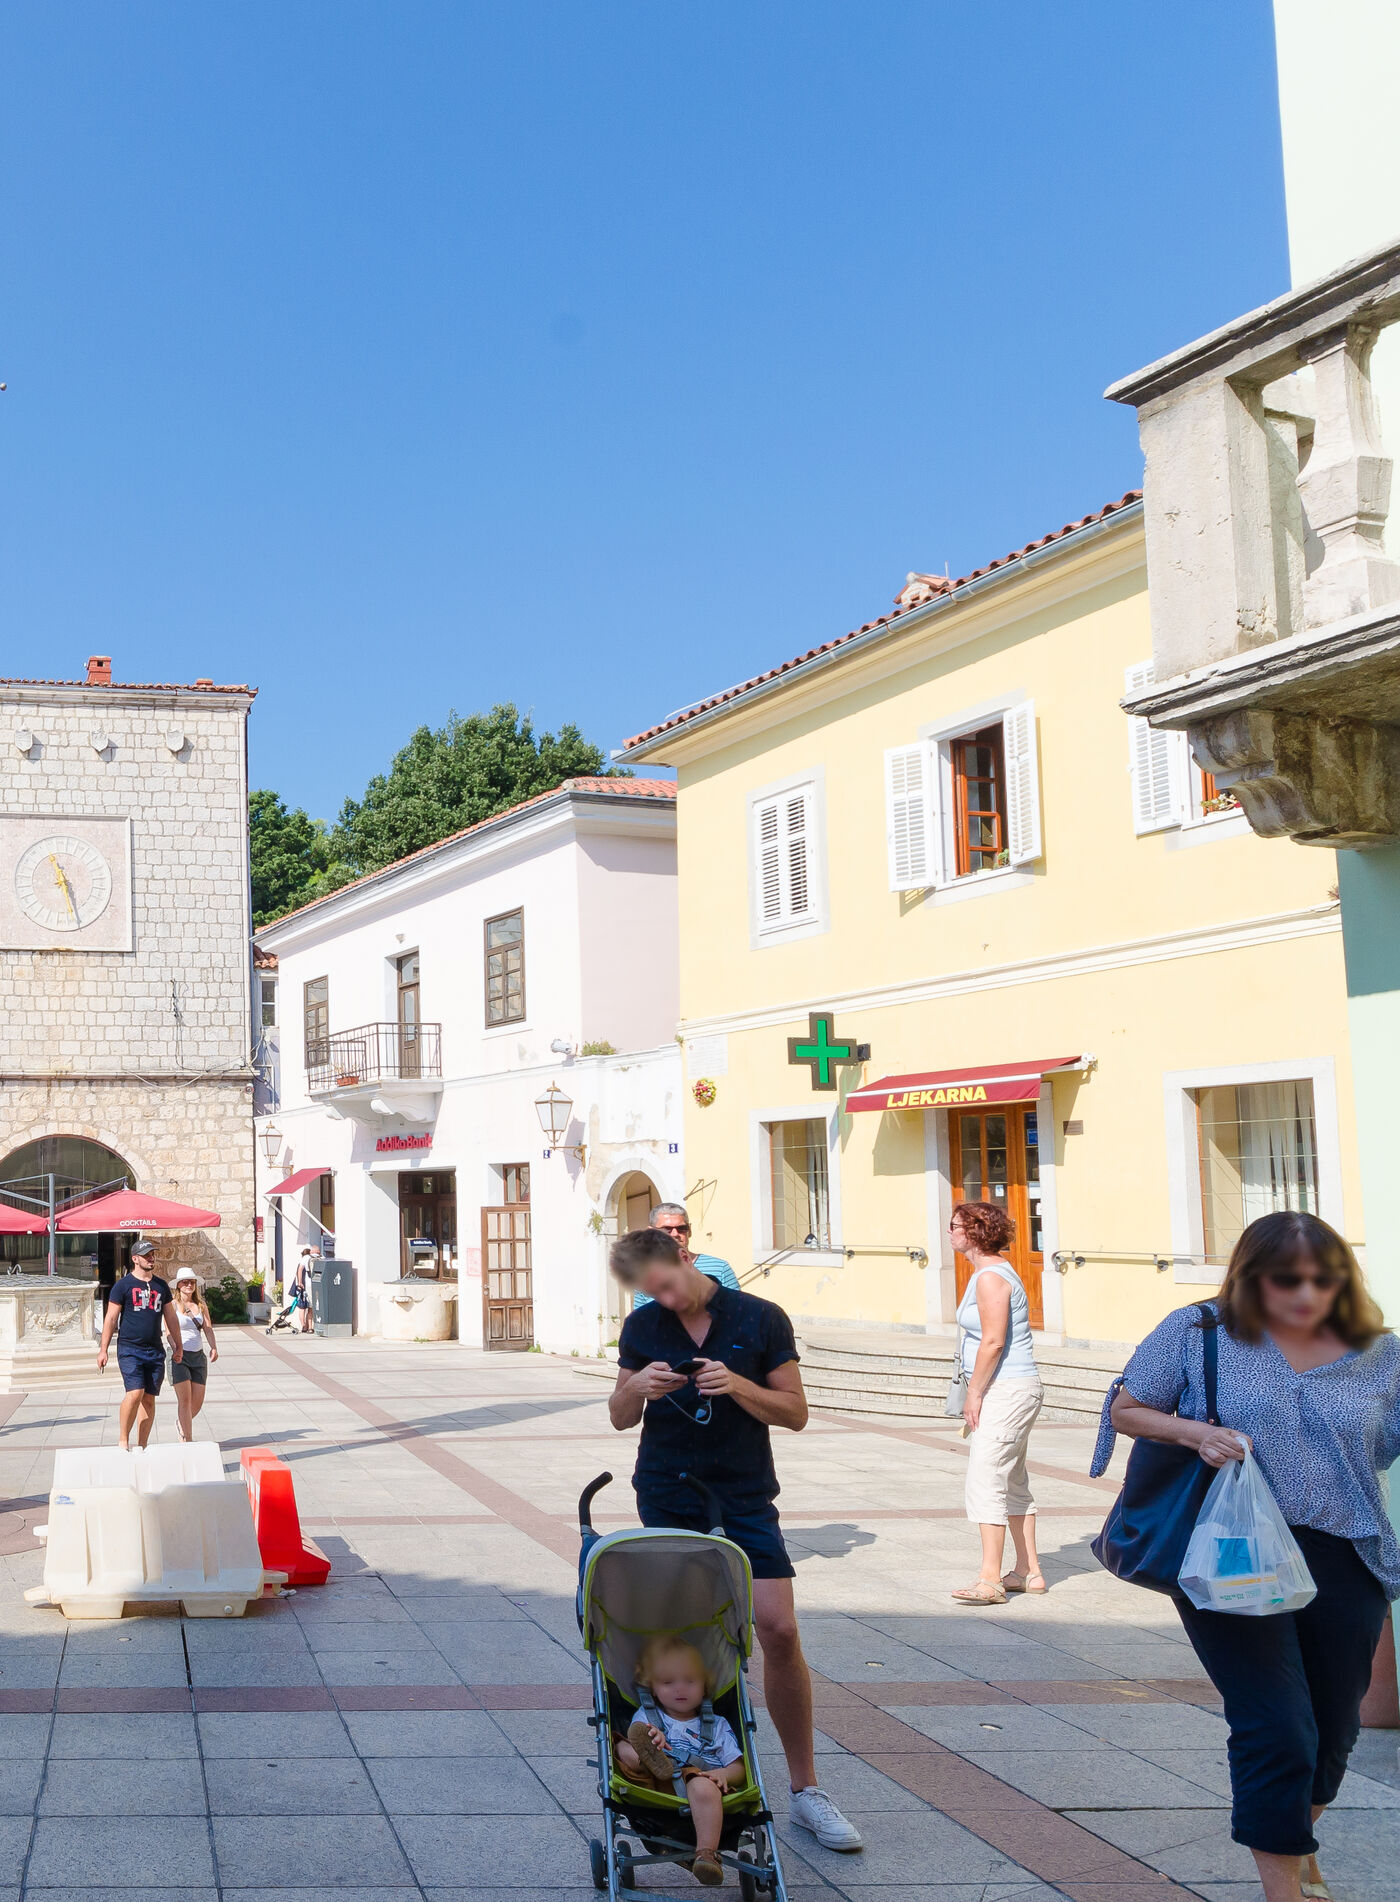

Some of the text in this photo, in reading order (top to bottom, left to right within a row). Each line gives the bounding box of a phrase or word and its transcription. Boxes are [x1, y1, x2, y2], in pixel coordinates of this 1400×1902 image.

[886, 1085, 988, 1108] LJEKARNA
[376, 1132, 432, 1151] Addiko Bank
[119, 1219, 157, 1227] COCKTAILS
